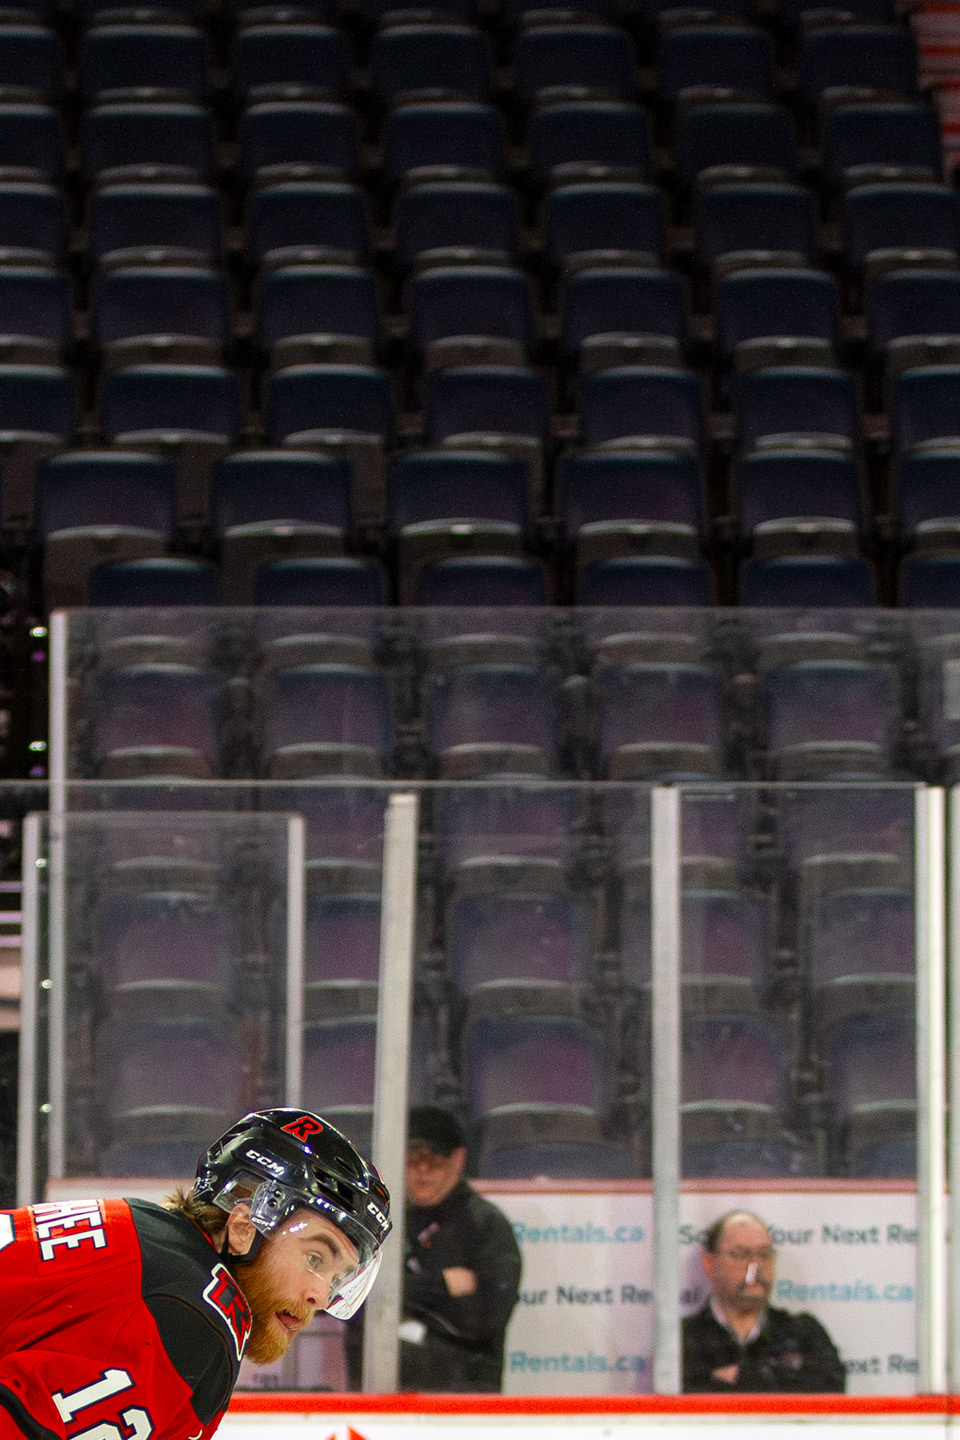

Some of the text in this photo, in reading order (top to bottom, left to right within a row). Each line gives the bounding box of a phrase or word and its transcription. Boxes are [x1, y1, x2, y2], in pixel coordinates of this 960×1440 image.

[280, 1116, 323, 1142] R
[245, 1149, 286, 1177] CCM
[31, 1200, 108, 1261] HEE
[822, 1225, 878, 1244] Next
[556, 1285, 614, 1305] Next
[775, 1280, 914, 1302] Rentals.ca
[509, 1351, 647, 1374] Rentals.ca
